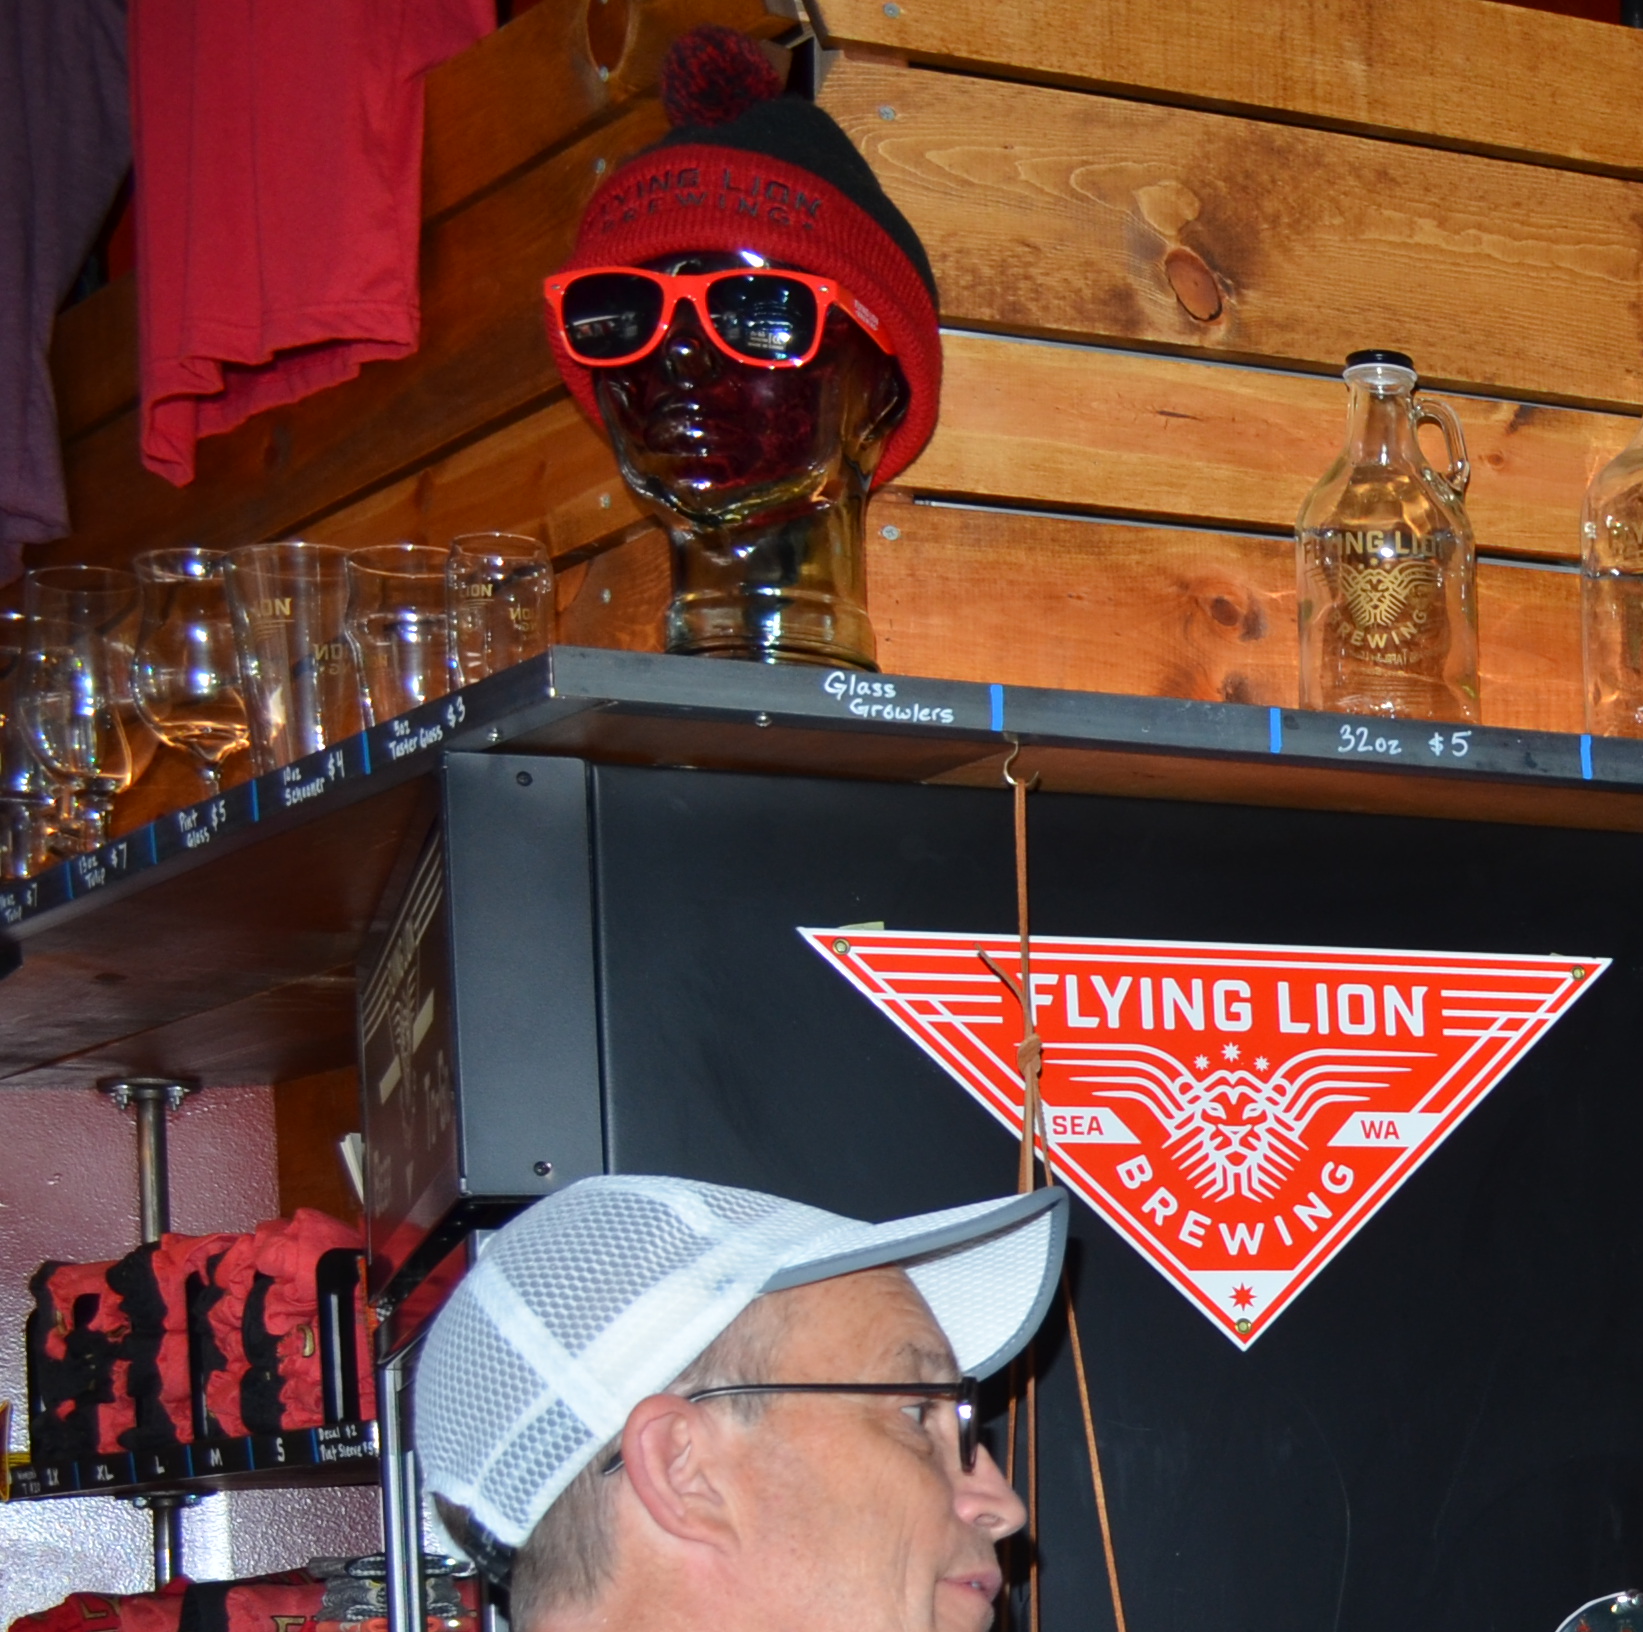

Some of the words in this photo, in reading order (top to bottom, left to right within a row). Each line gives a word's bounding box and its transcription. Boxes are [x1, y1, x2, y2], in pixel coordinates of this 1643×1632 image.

[823, 670, 897, 698] Glass
[447, 701, 466, 729] $3
[850, 699, 955, 724] Growlers
[1337, 724, 1402, 756] 32oz
[1428, 730, 1470, 757] $5
[327, 752, 344, 780] $4
[211, 803, 226, 827] $5
[111, 842, 127, 867] $7
[1017, 973, 1252, 1033] FLYING
[1277, 983, 1429, 1037] LION
[1052, 1114, 1105, 1137] SEA
[1361, 1119, 1400, 1141] WA
[1115, 1153, 1355, 1258] BREWING
[211, 1448, 223, 1466] M
[277, 1439, 286, 1461] S
[97, 1465, 114, 1481] XL
[155, 1456, 165, 1474] L
